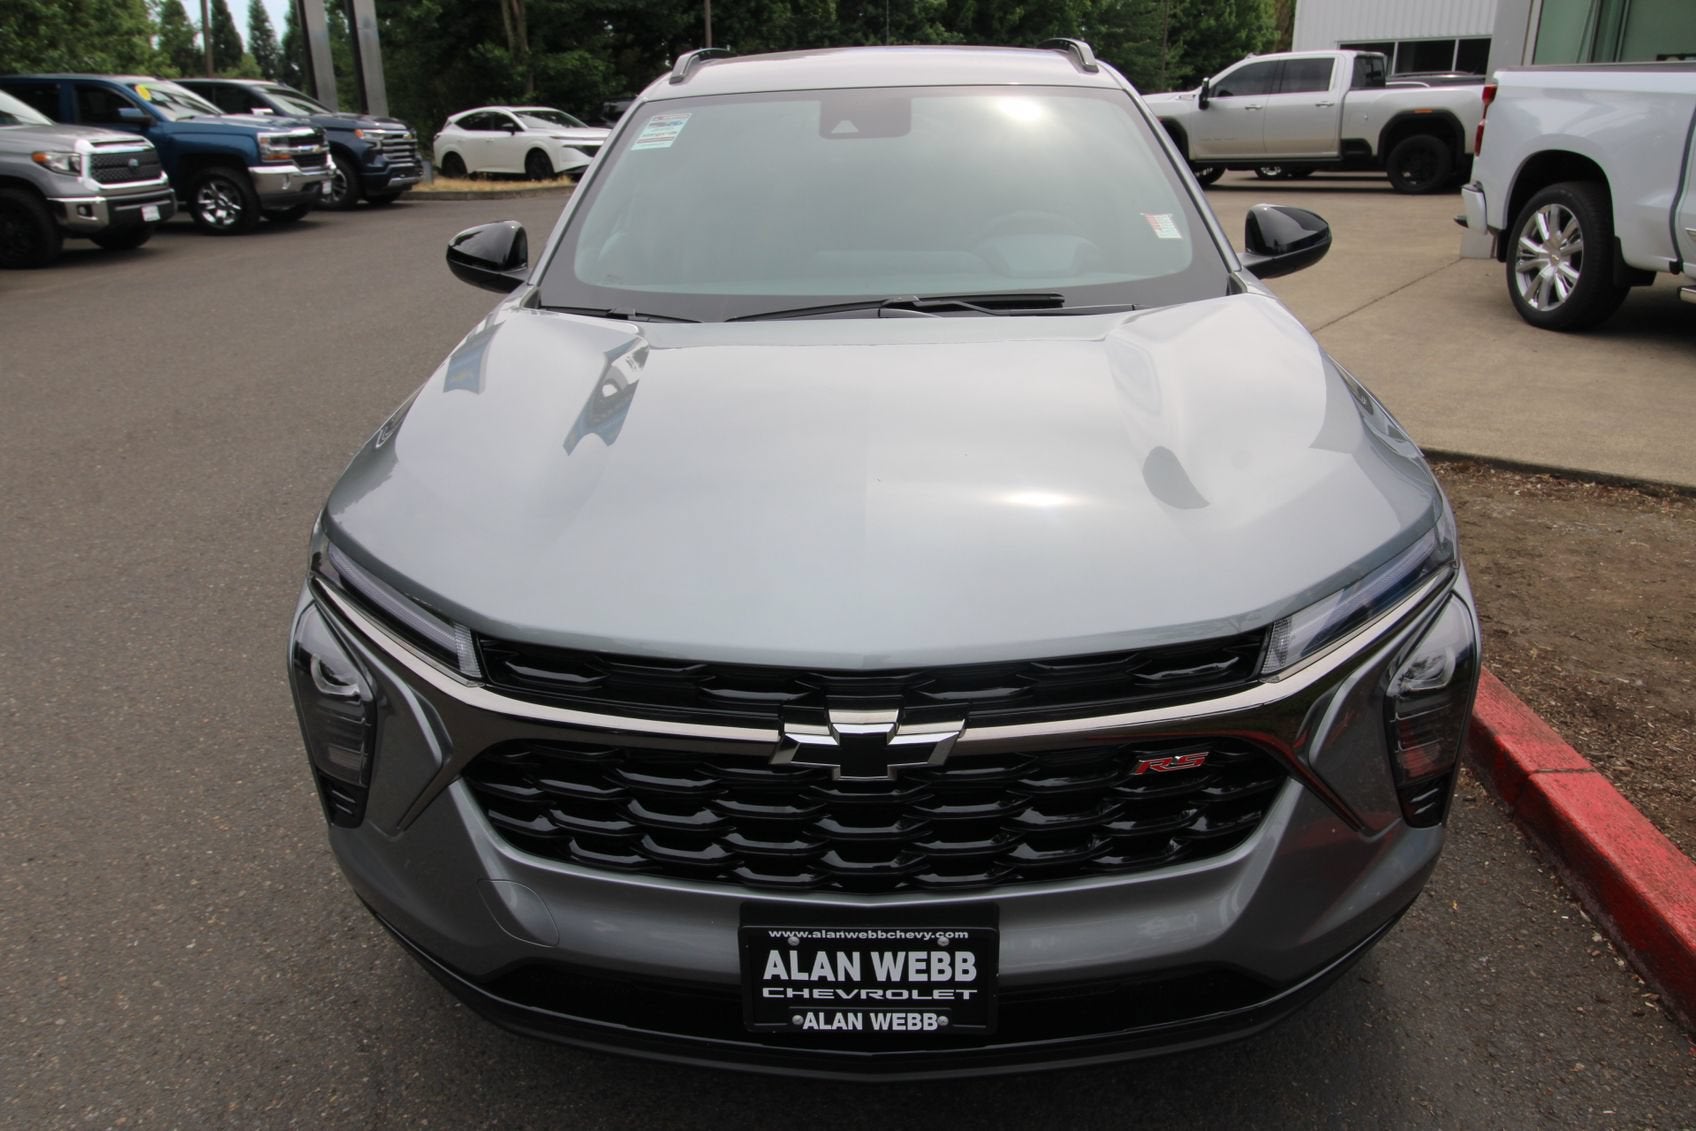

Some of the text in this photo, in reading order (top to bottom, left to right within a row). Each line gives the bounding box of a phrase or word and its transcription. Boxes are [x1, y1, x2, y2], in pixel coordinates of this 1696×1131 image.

[1132, 752, 1209, 775] RS
[768, 930, 969, 940] www.alanwebbchevy.com
[762, 950, 978, 982] ALAN WEBB
[762, 987, 978, 1000] CHEVROLET
[802, 1011, 938, 1031] ALAN WEBB
